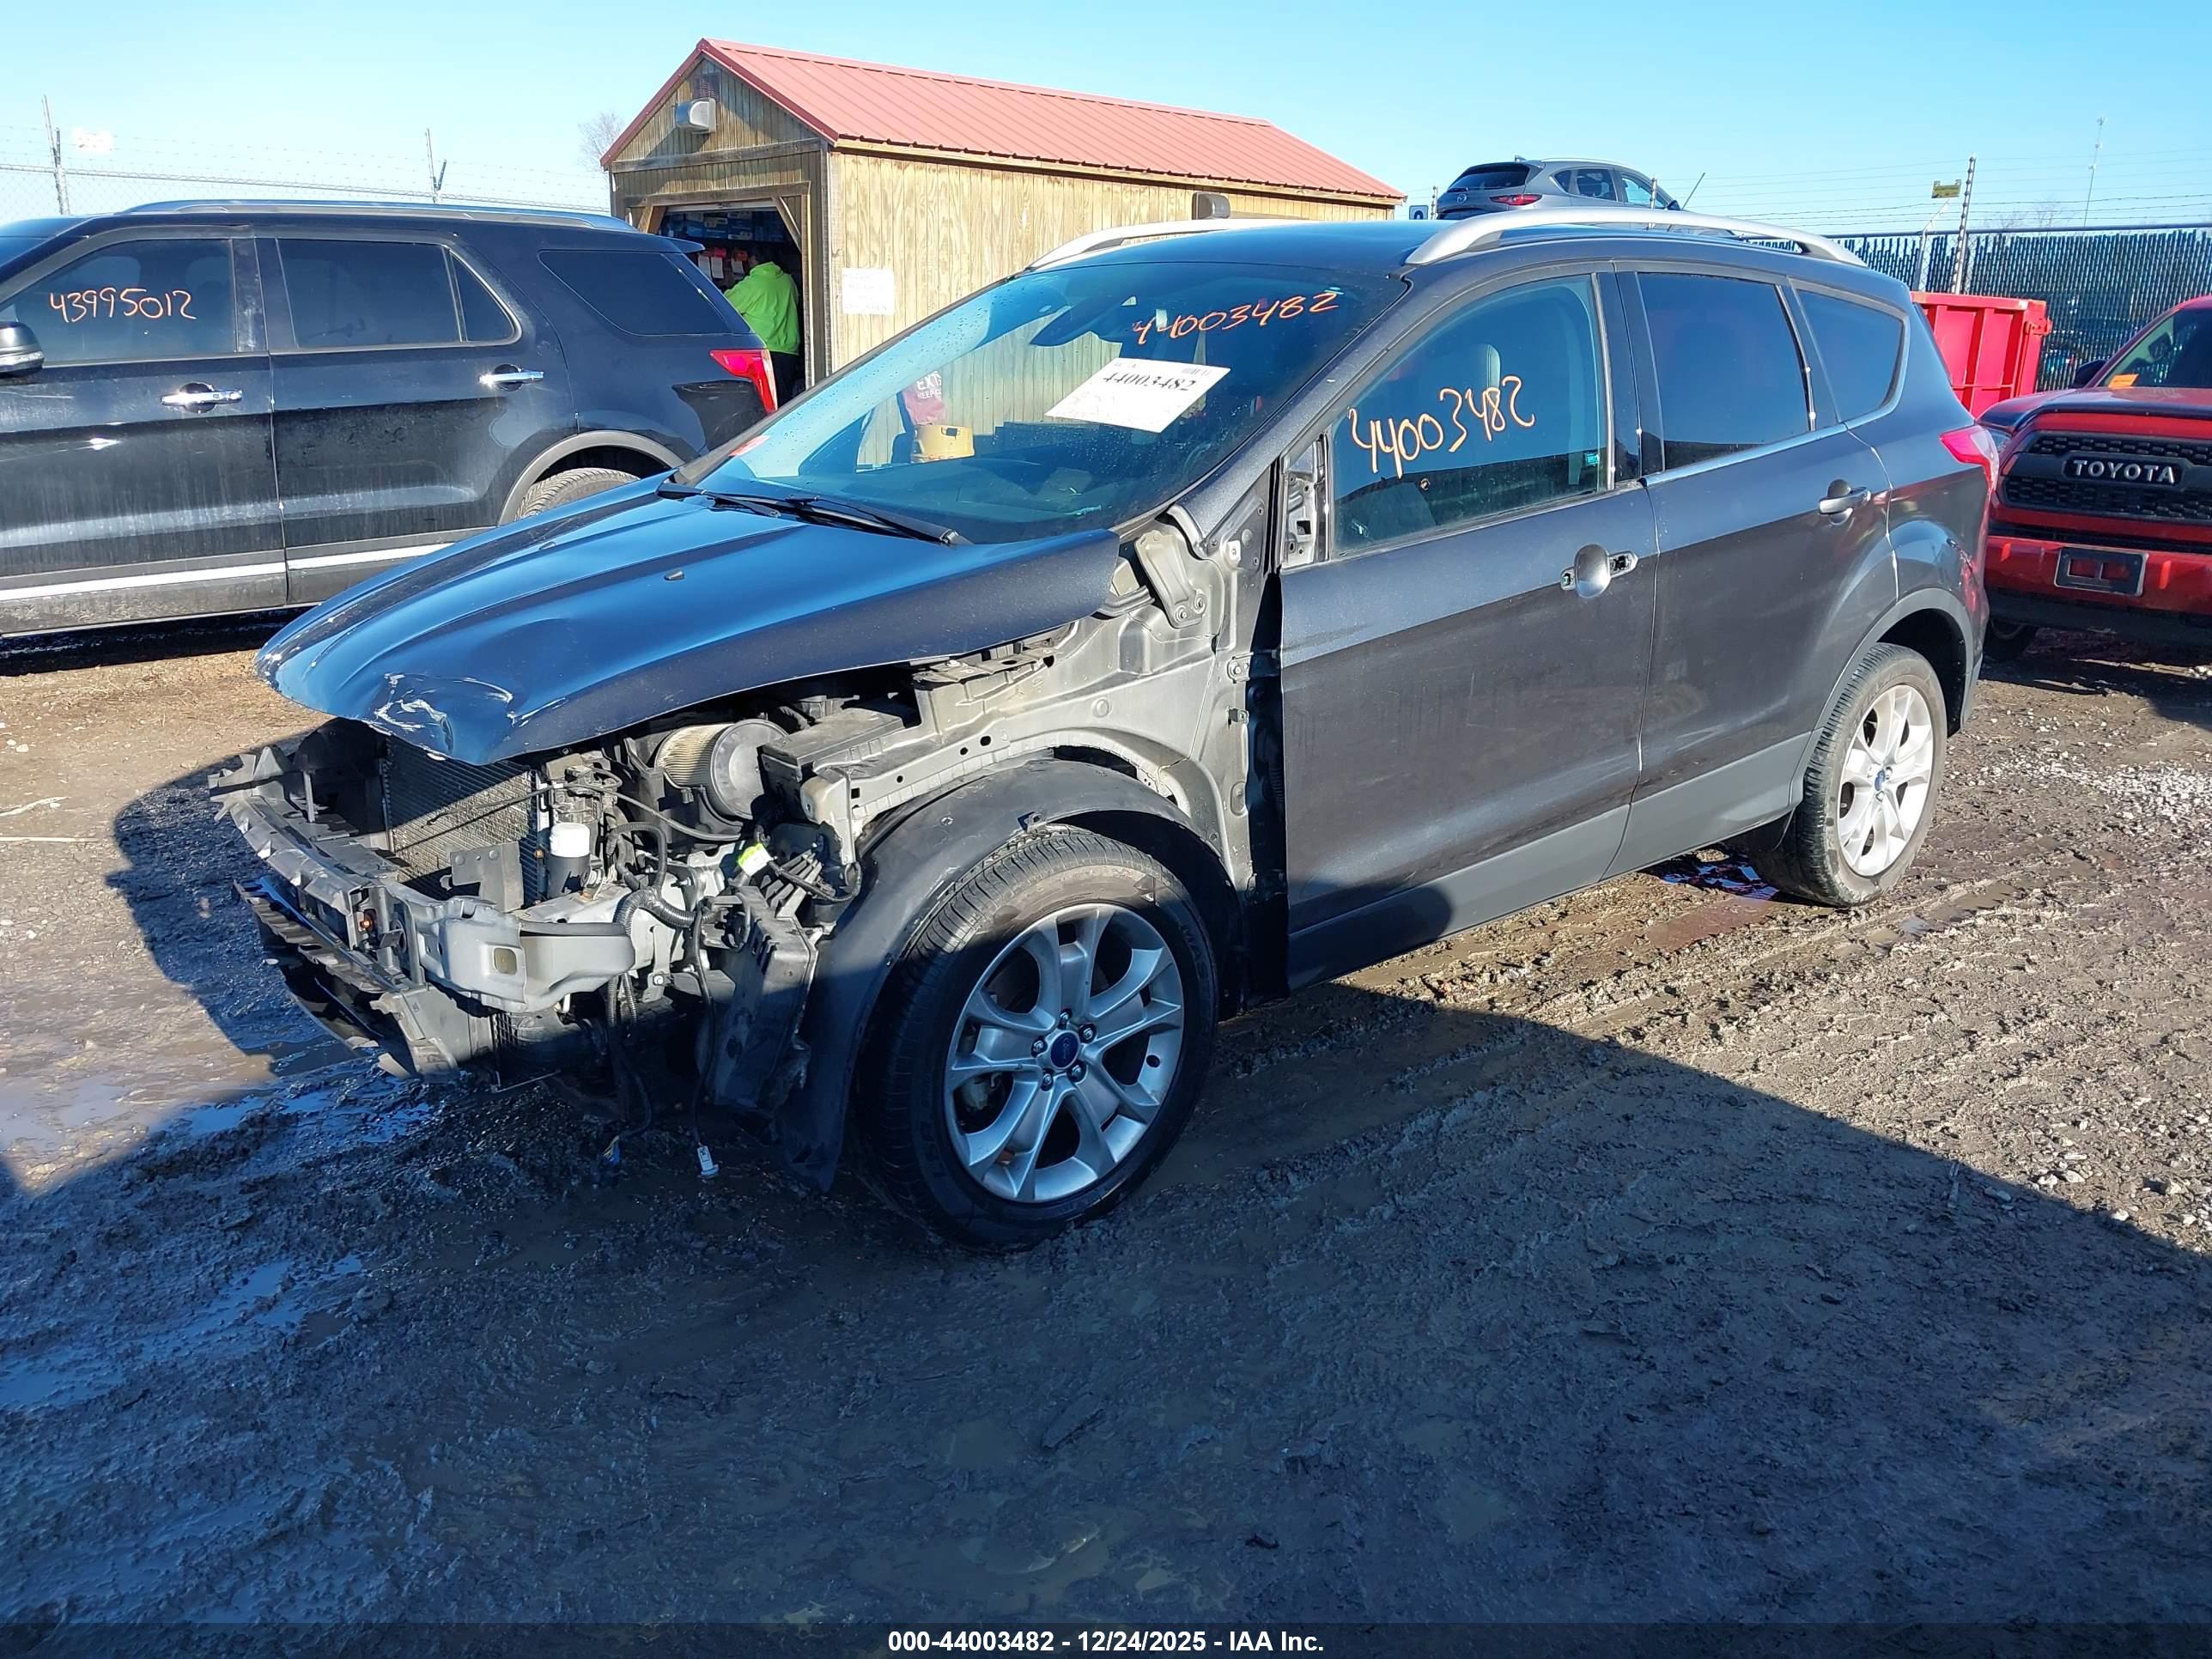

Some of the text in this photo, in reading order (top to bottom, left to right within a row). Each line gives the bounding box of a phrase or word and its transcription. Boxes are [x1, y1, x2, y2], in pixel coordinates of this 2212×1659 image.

[49, 286, 198, 324] 43995012
[1131, 291, 1340, 345] 44003482
[1102, 371, 1197, 392] 44003482
[1346, 374, 1537, 479] 44003482
[2072, 459, 2176, 485] TOYOTA
